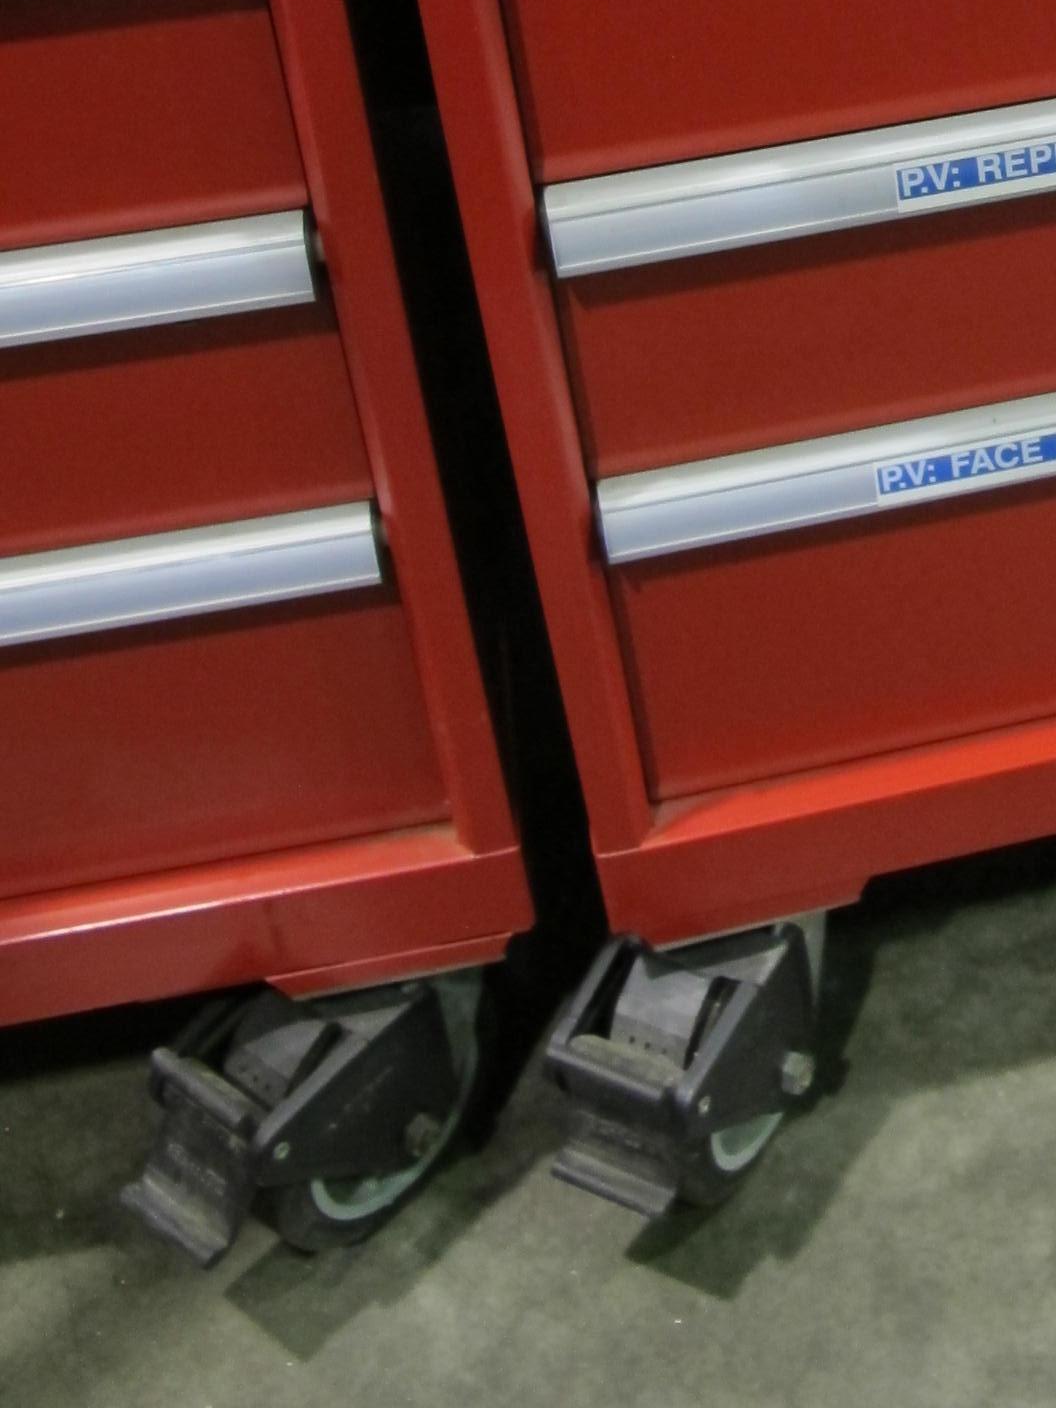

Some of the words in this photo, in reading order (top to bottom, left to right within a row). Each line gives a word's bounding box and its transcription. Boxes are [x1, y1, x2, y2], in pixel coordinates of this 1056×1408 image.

[900, 163, 962, 198] P.V:
[881, 459, 938, 493] P.V:
[951, 437, 1044, 478] FACE
